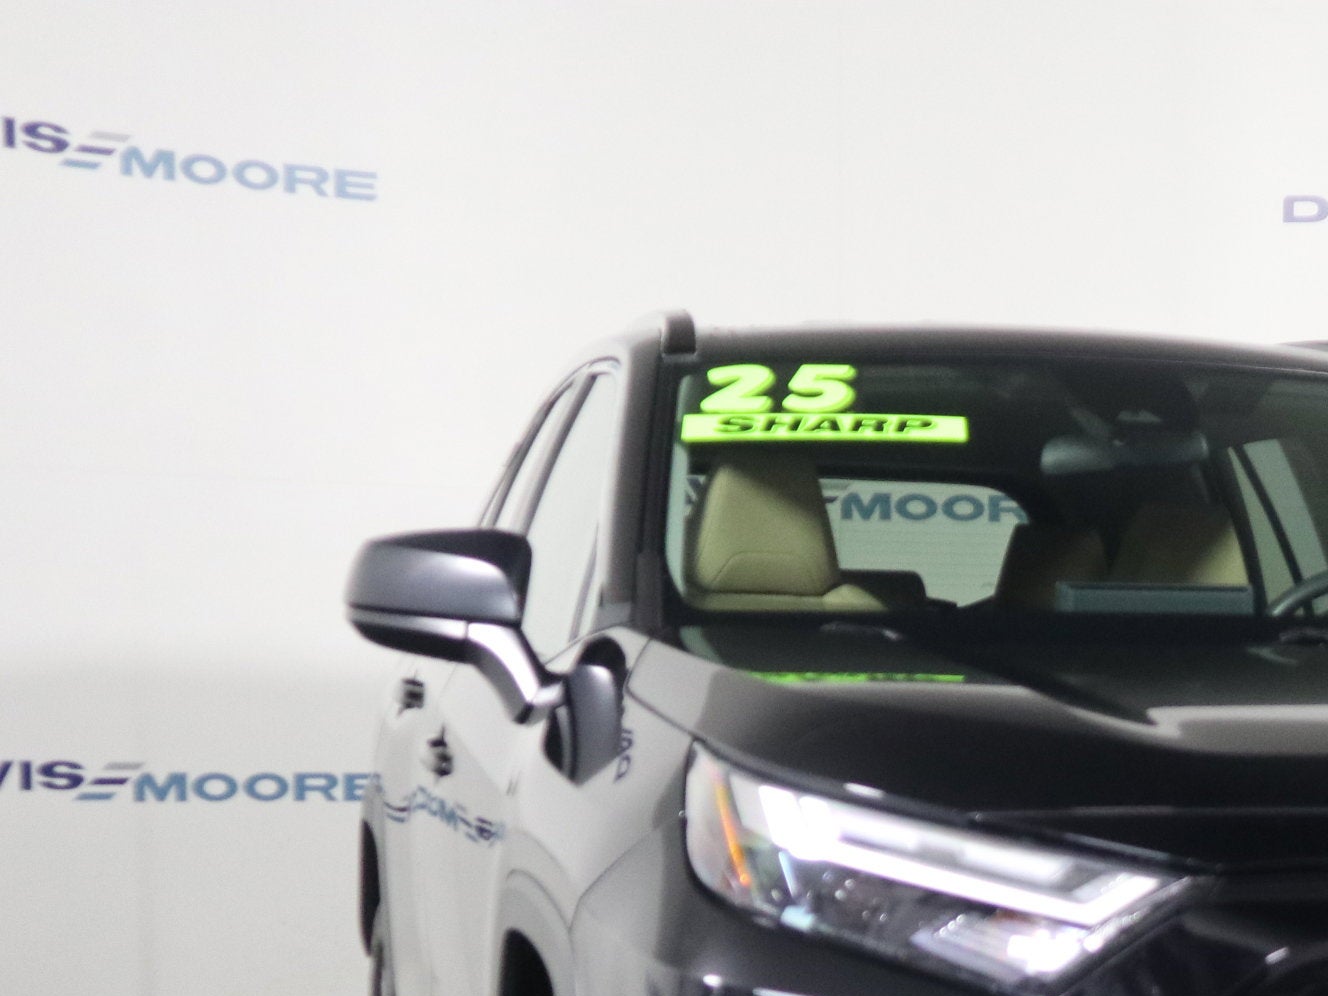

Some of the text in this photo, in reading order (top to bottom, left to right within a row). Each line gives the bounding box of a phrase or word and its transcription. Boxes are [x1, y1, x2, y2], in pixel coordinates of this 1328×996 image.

[119, 145, 379, 201] MOORE
[700, 363, 858, 413] 25
[715, 414, 937, 434] SHARP
[133, 772, 371, 802] MOORE
